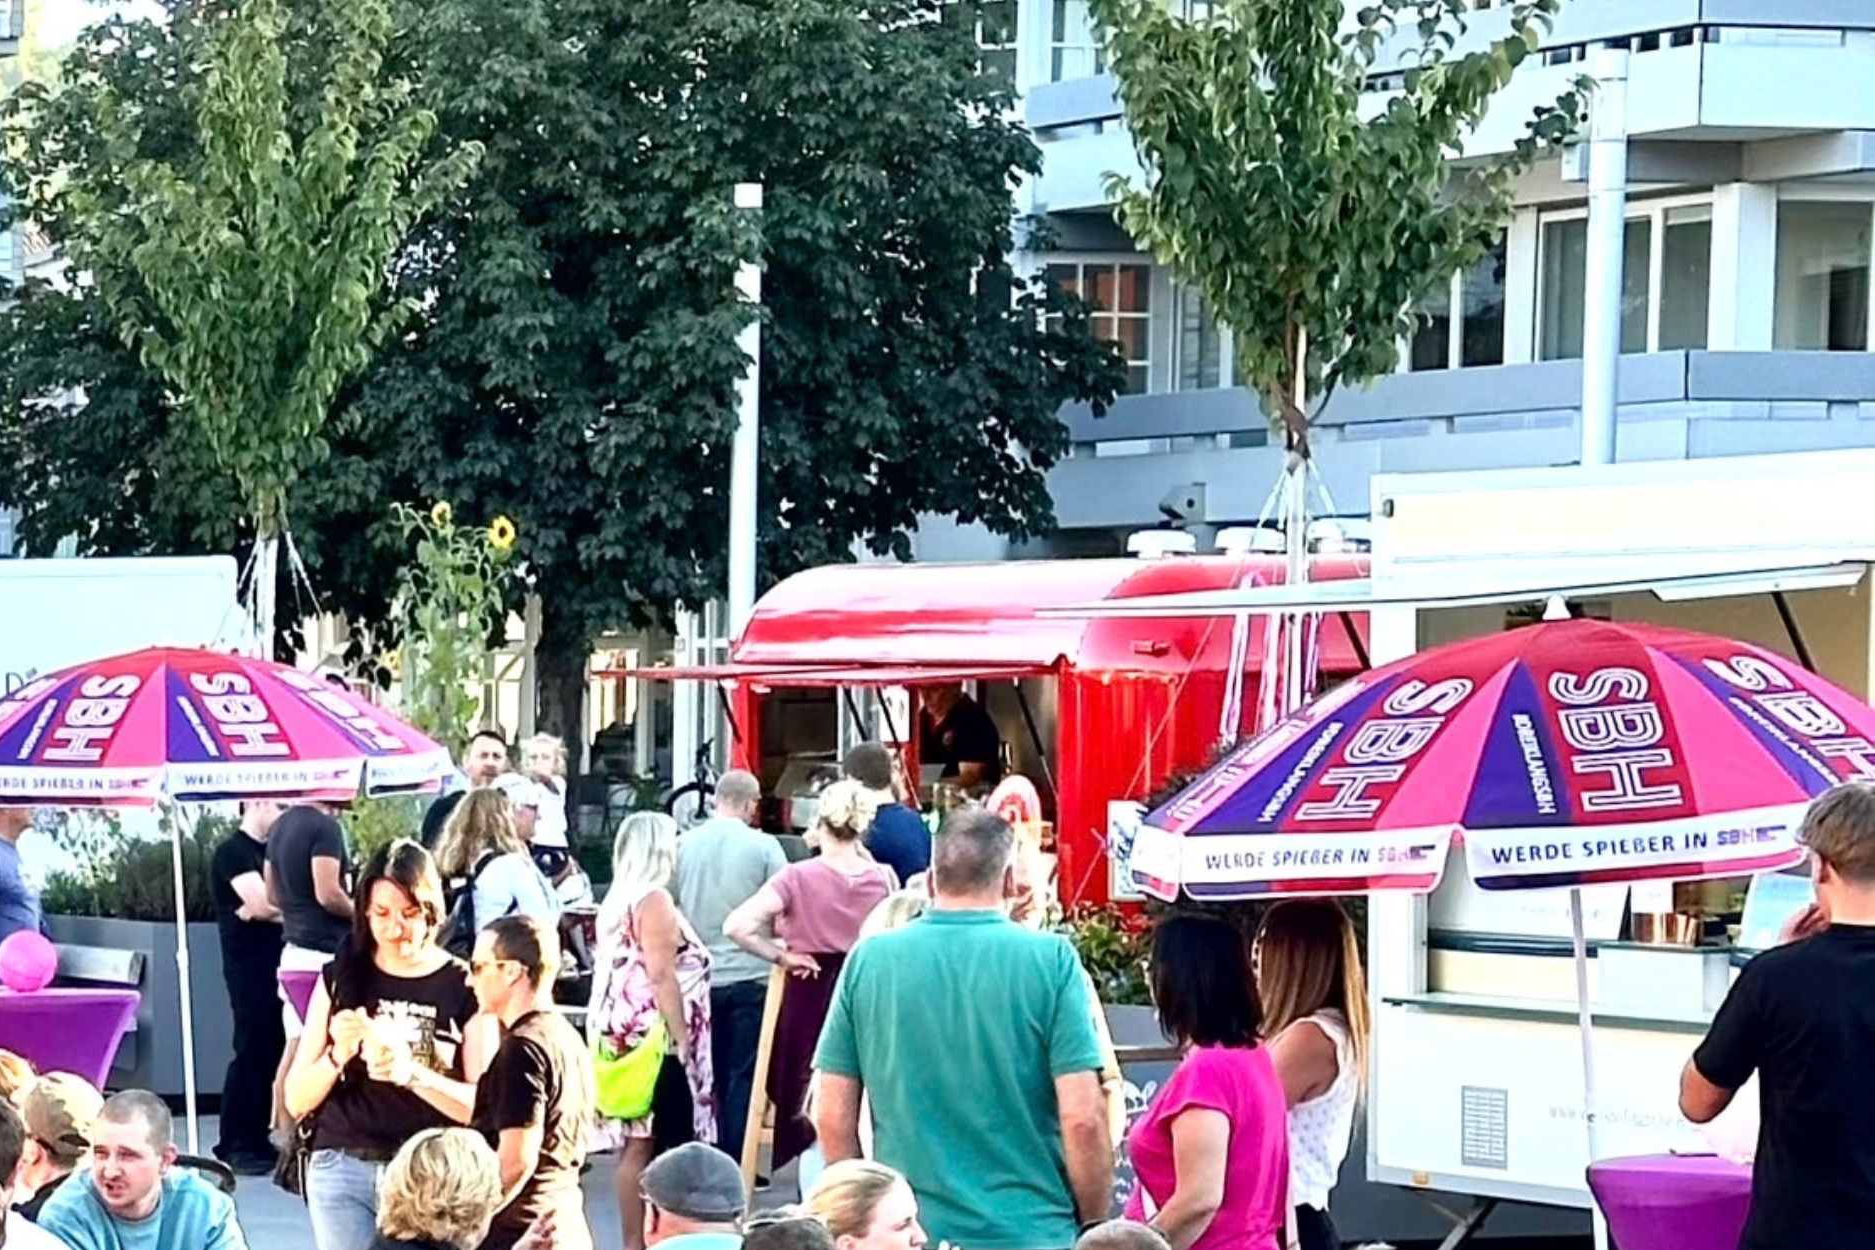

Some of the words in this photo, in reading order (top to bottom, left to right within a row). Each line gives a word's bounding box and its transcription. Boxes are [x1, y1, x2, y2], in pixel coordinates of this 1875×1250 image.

[1294, 677, 1474, 822] SBH
[1549, 666, 1683, 813] SBH
[1350, 848, 1370, 863] IN
[1491, 842, 1573, 864] WERDE
[1684, 832, 1708, 849] IN
